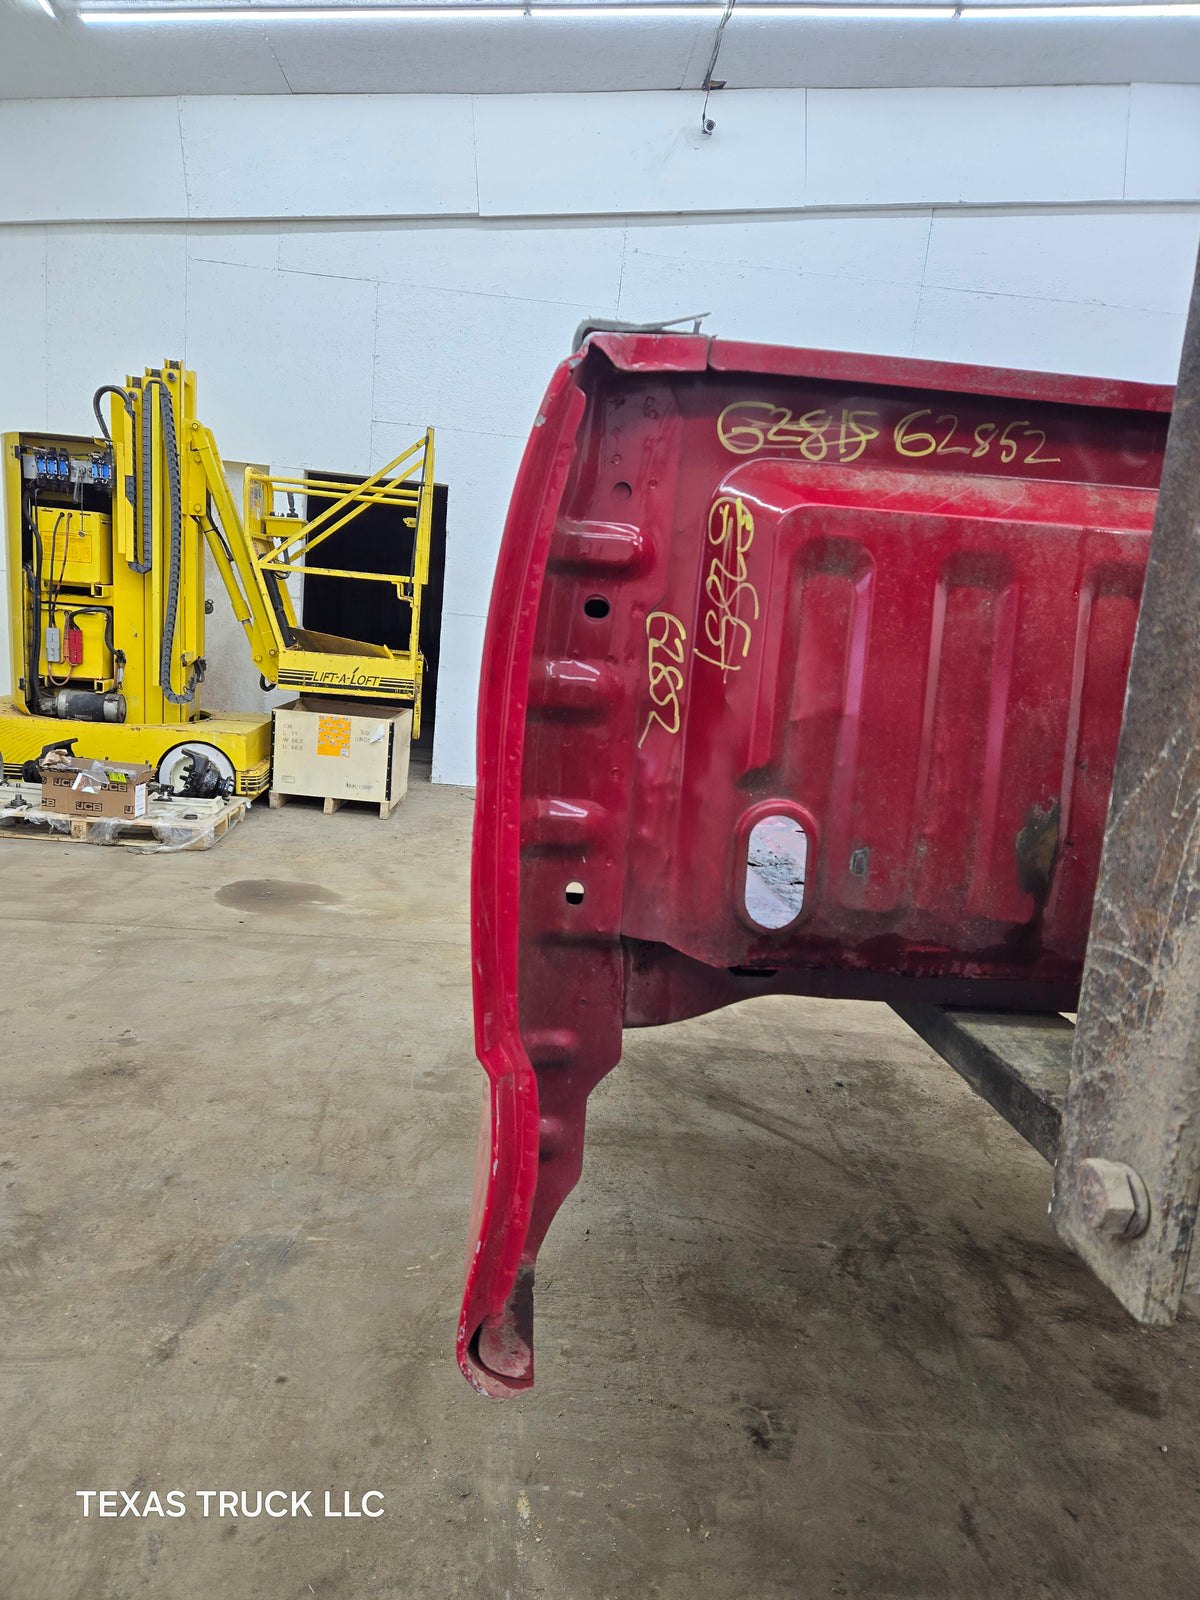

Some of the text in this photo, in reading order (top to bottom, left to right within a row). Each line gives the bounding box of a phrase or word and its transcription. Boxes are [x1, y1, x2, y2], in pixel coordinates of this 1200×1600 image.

[894, 410, 1061, 463] 62852
[313, 667, 380, 686] LIFT-A-LOFT
[638, 612, 685, 748] 62852
[41, 798, 55, 807] CB
[75, 801, 102, 812] JCB
